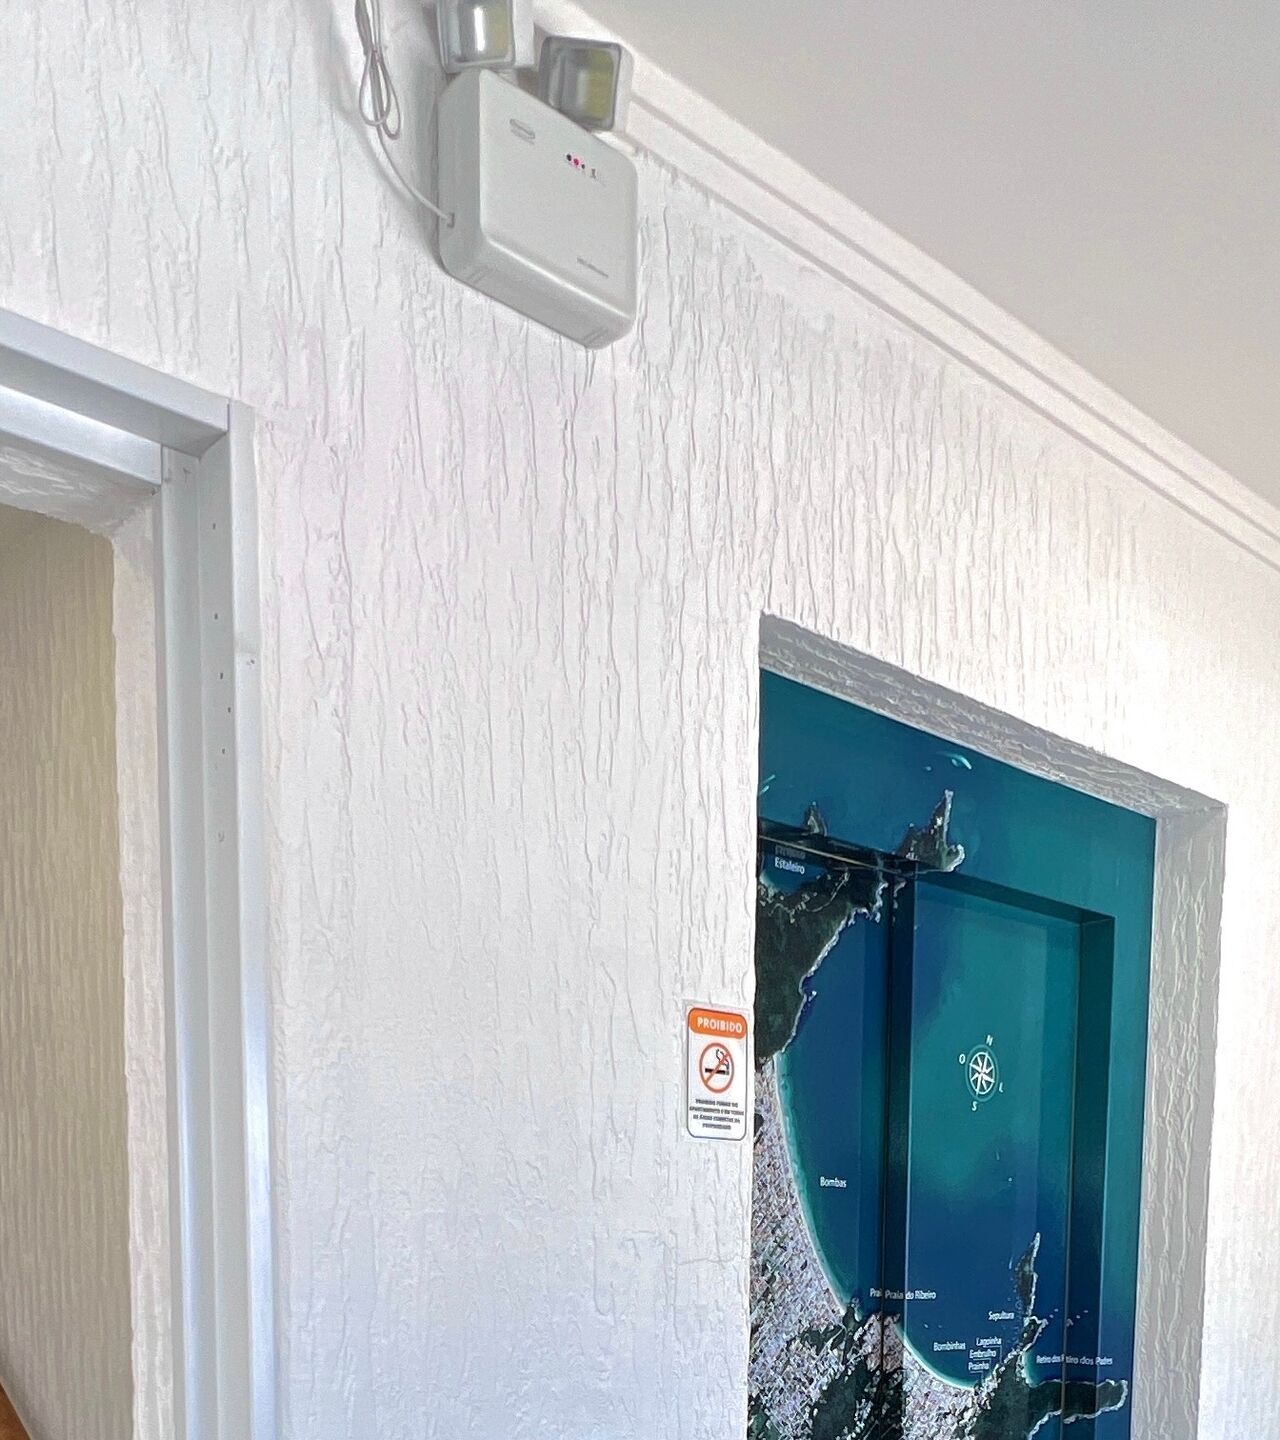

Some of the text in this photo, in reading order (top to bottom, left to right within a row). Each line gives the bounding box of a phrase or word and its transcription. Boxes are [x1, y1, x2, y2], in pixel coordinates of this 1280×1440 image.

[774, 856, 805, 875] Estaleiro
[697, 1016, 742, 1034] PROIBIDO
[986, 1034, 993, 1046] N
[972, 1101, 978, 1112] S
[820, 1176, 847, 1188] Bombas
[884, 1289, 937, 1300] Praia do Ribeiro
[933, 1341, 966, 1351] Bombinhas
[968, 1361, 990, 1371] Prainha
[1079, 1356, 1094, 1366] dos
